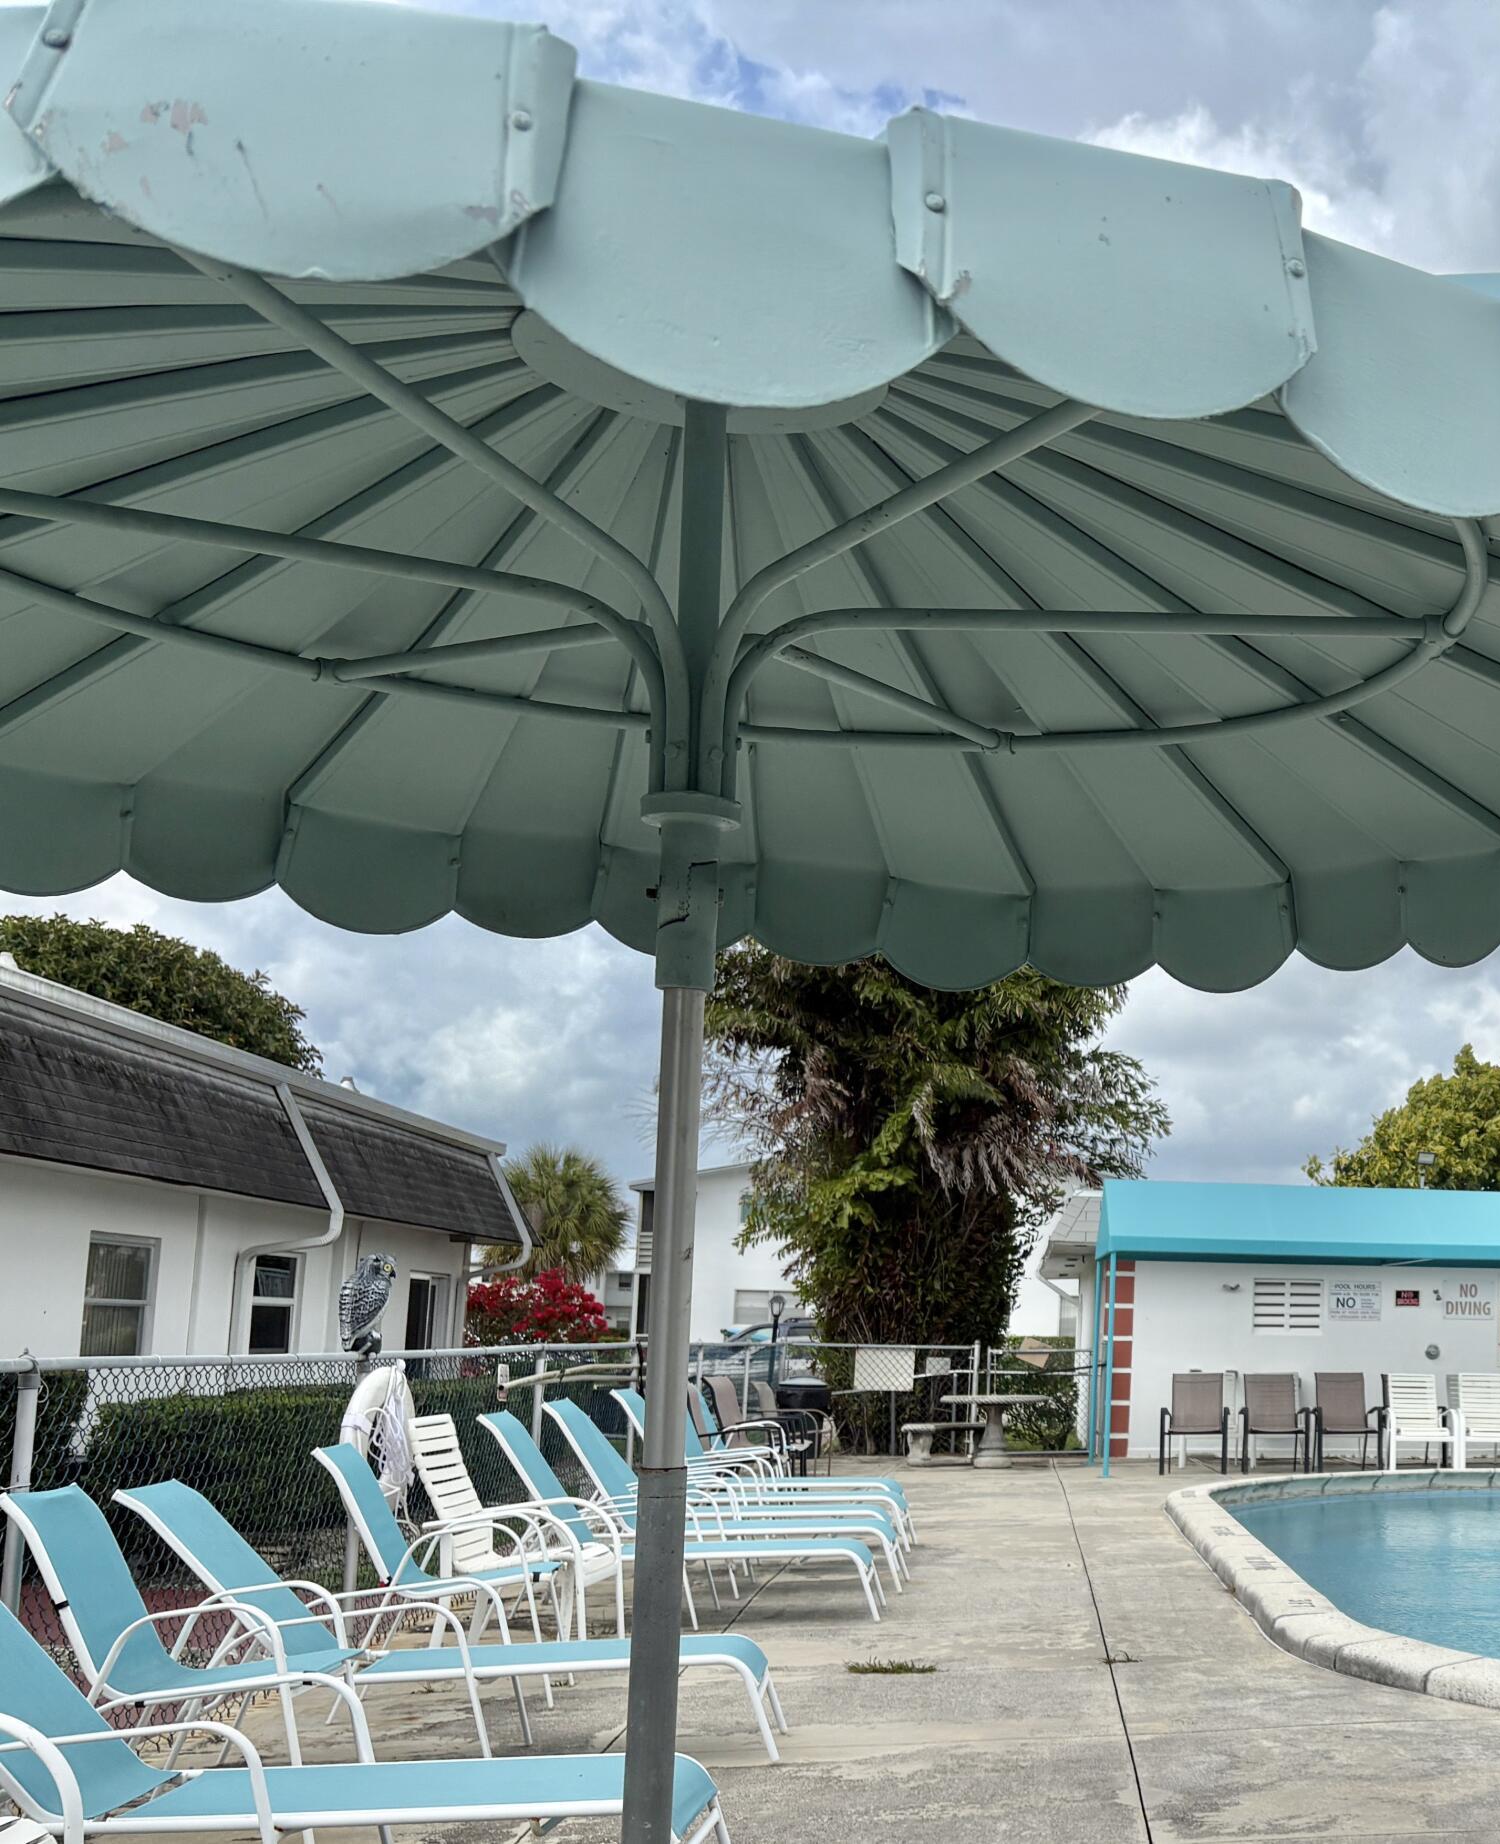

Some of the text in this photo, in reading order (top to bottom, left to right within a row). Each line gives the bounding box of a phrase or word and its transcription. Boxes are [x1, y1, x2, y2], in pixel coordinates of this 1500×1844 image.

[1460, 1283, 1478, 1298] NO
[1336, 1296, 1356, 1308] NO
[1445, 1300, 1491, 1315] DIVING
